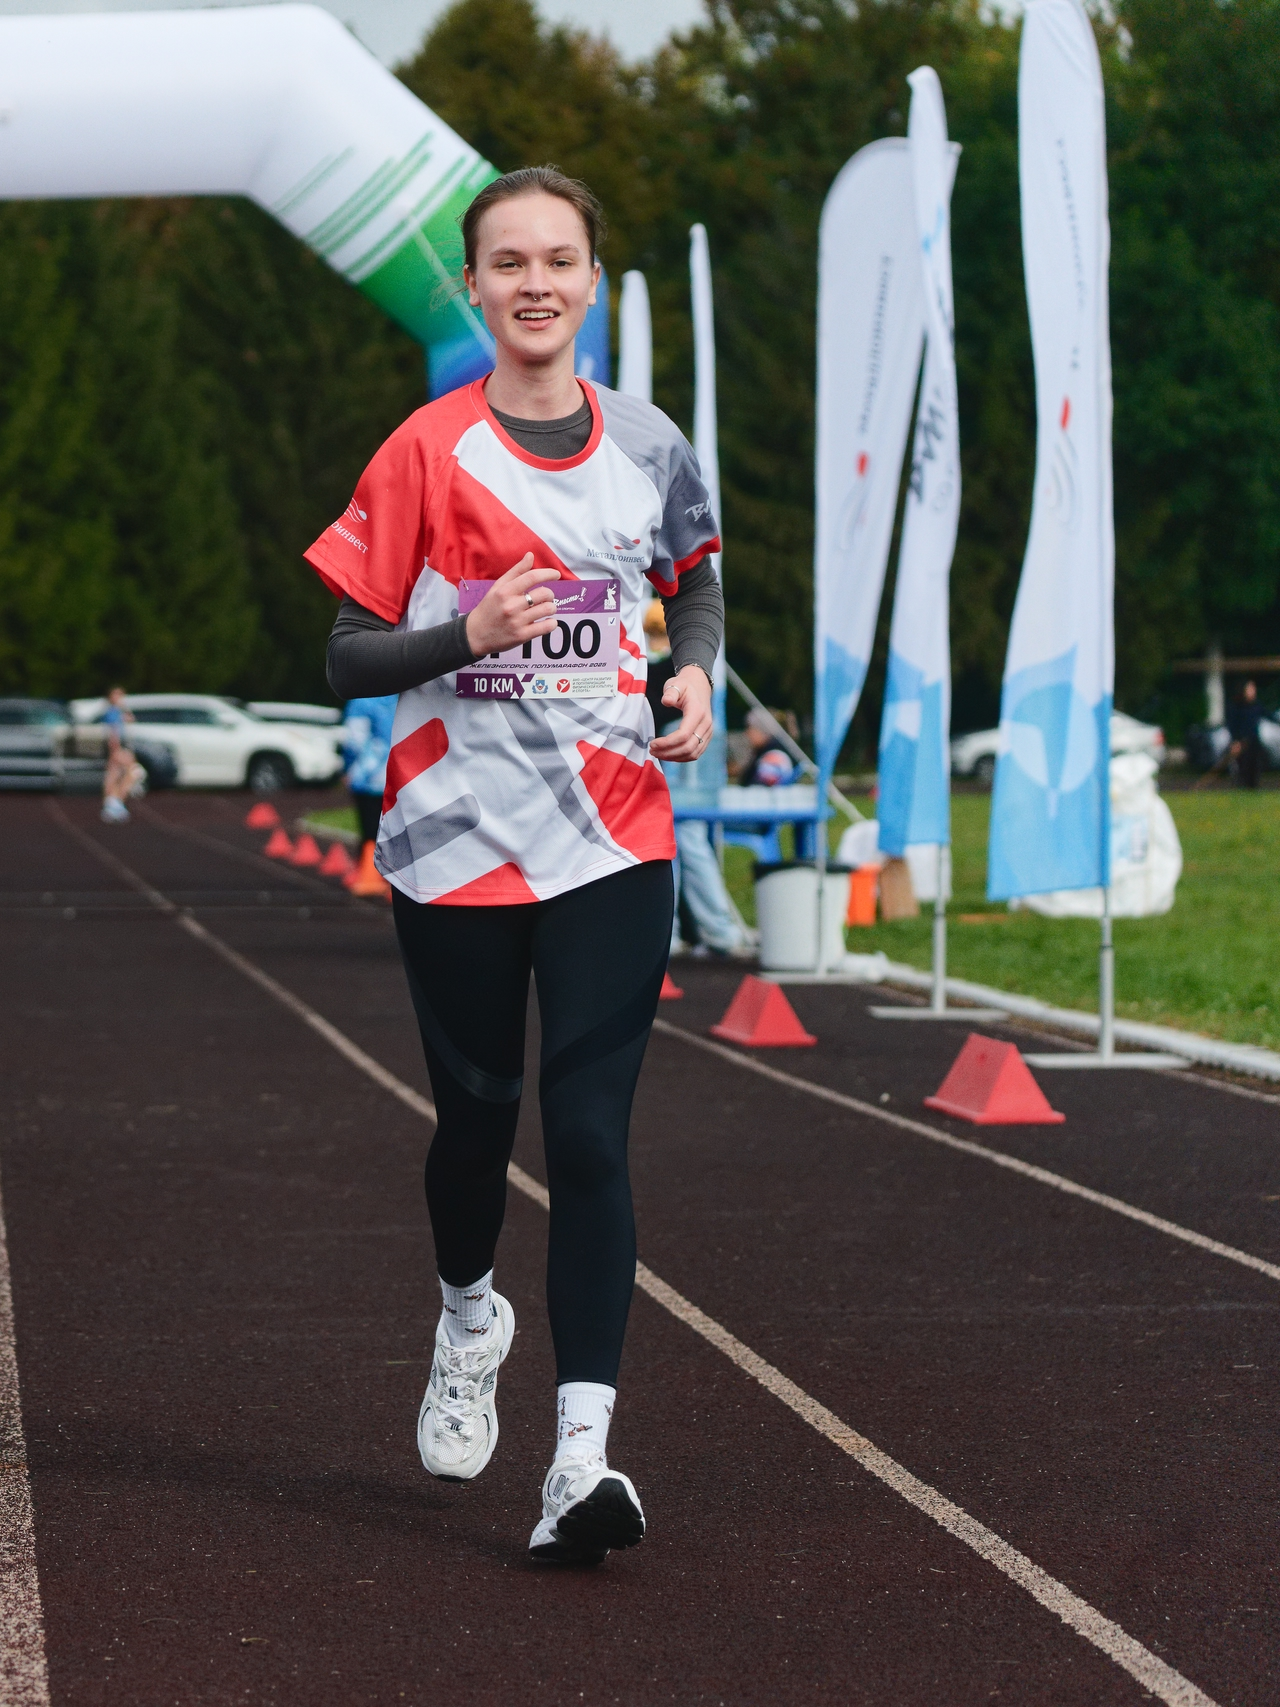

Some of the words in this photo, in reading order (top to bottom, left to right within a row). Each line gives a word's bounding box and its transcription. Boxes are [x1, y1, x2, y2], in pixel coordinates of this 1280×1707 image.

[490, 618, 601, 660] 00
[474, 677, 487, 693] 10
[491, 677, 513, 694] КМ
